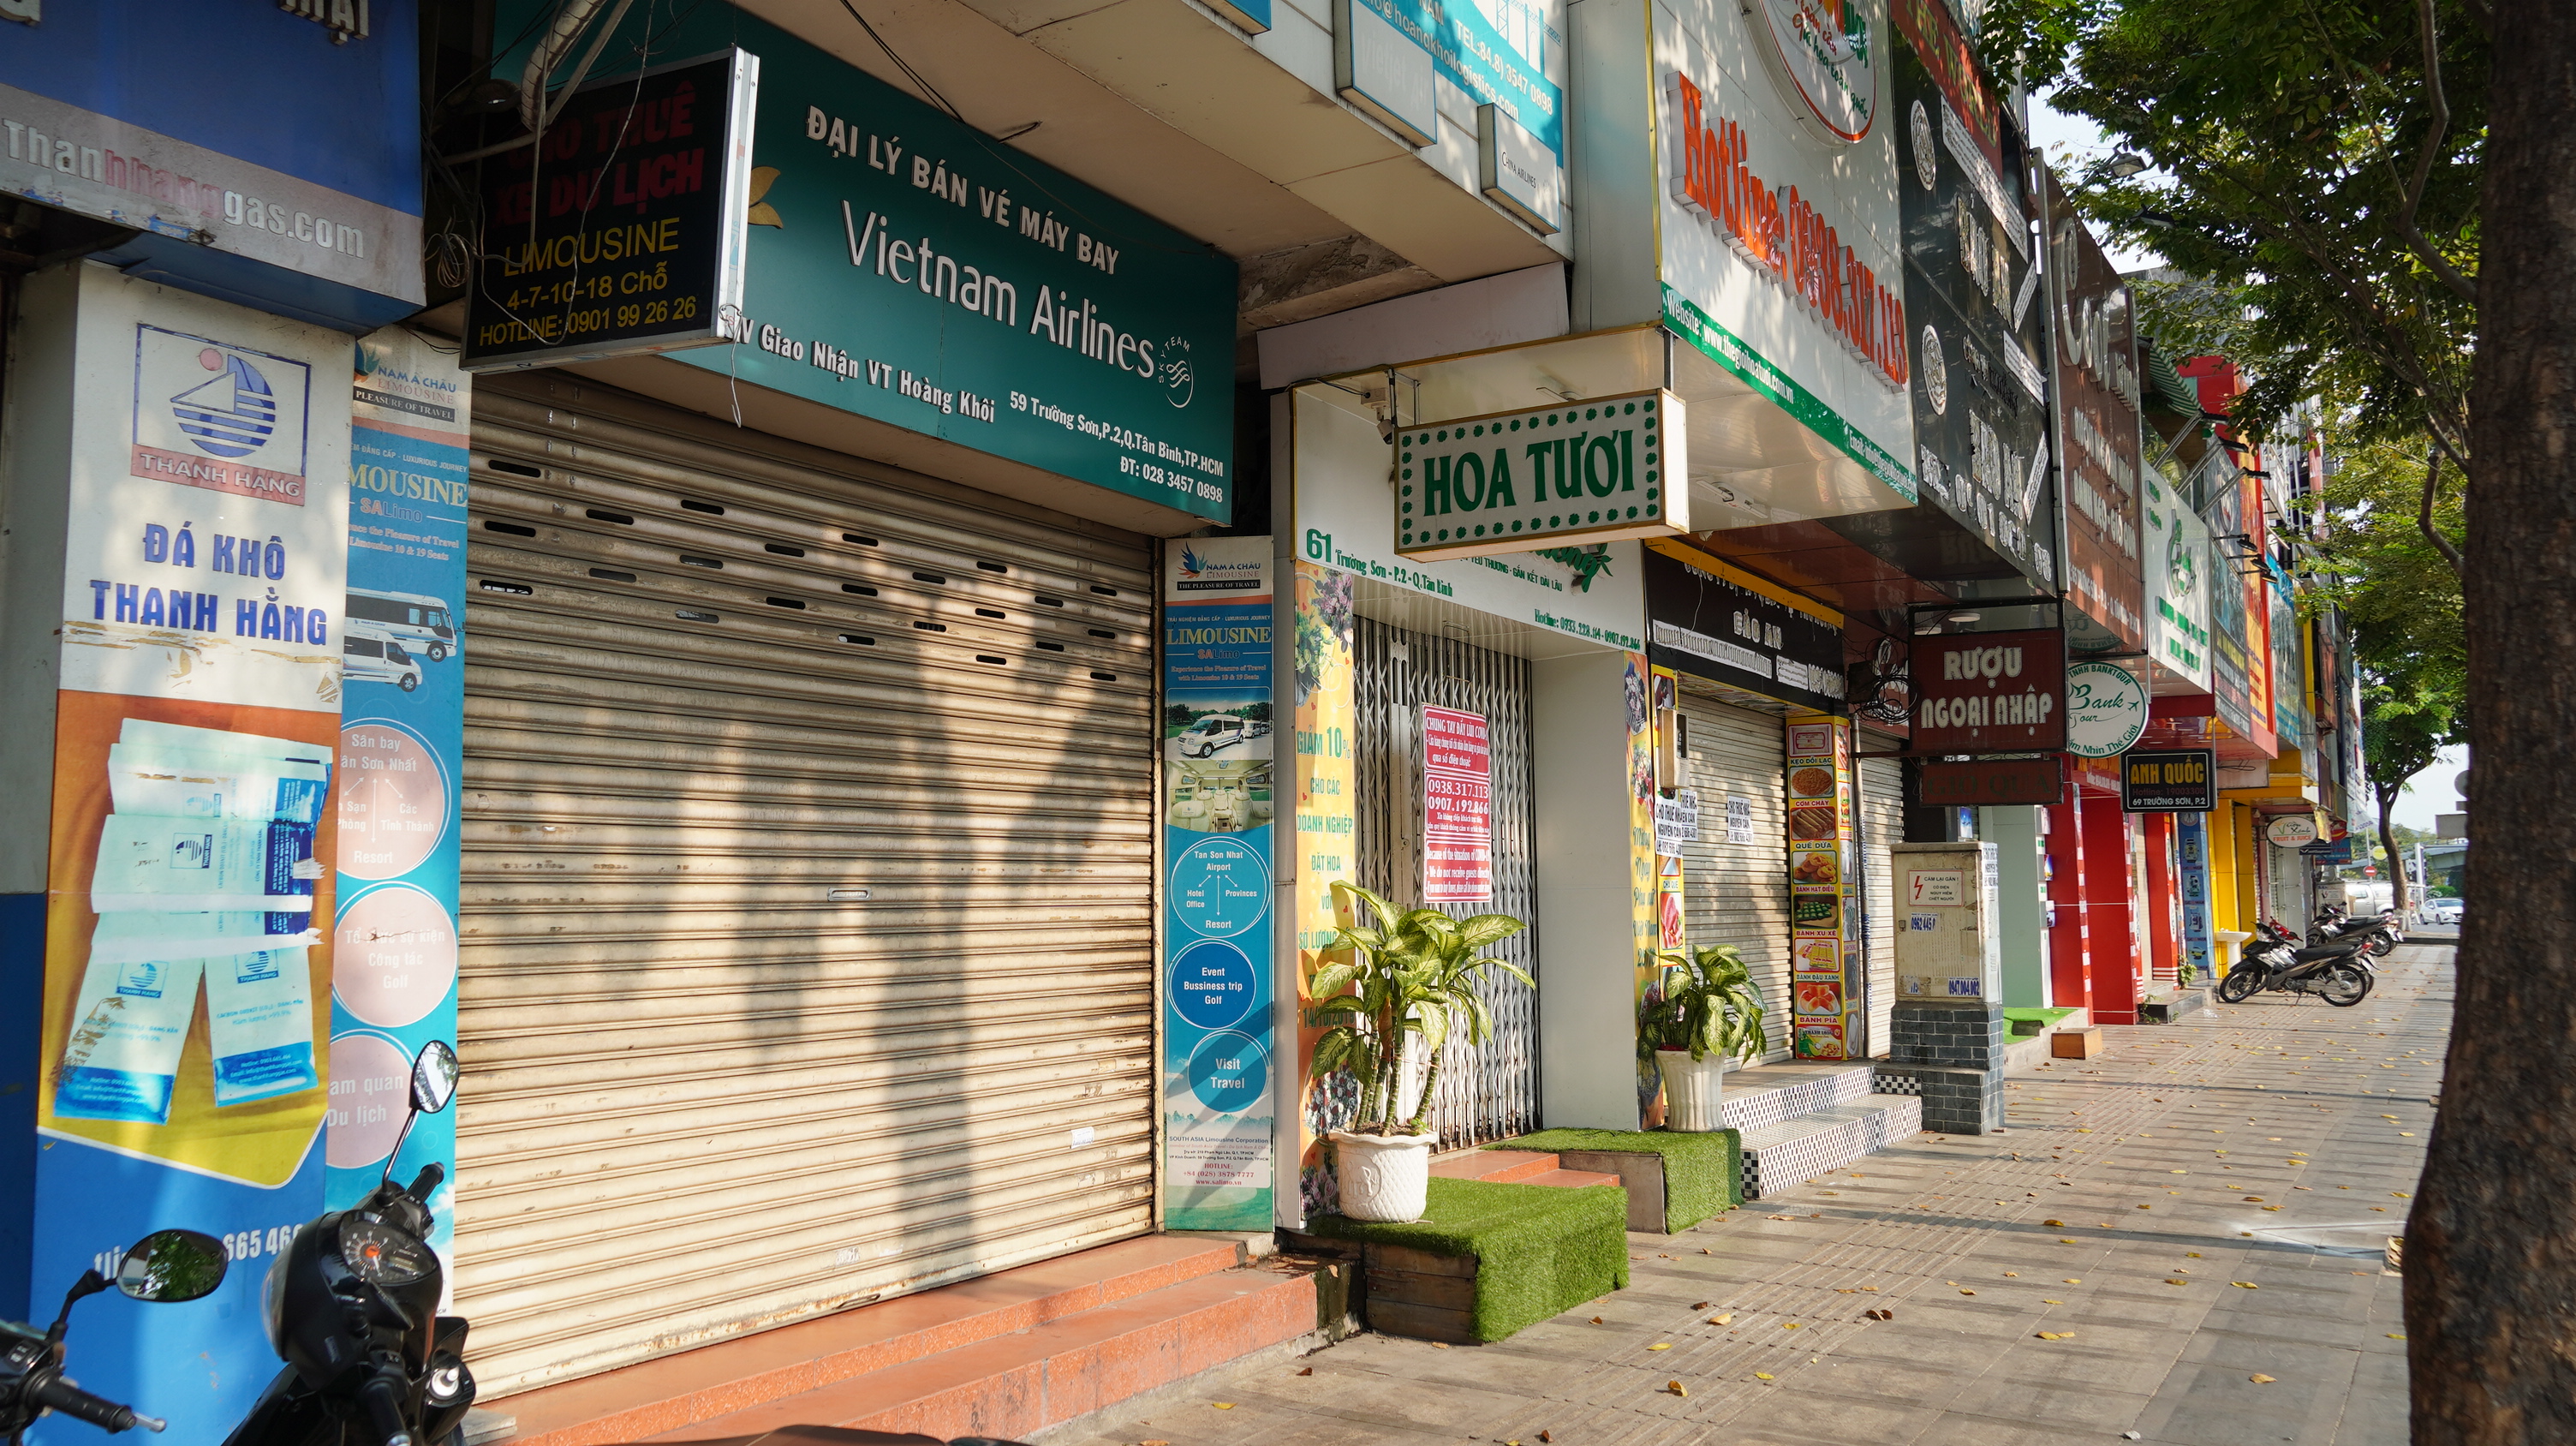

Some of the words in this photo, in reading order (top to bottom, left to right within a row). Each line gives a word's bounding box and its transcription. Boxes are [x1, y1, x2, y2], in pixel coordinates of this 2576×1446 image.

[1506, 64, 1529, 96] 3547
[1530, 83, 1553, 117] 0898
[1501, 152, 1517, 175] CHINA
[1518, 166, 1536, 189] AIRLINES
[1673, 71, 1787, 283] Hotline:
[2, 117, 365, 260] Thanhhanggas.com
[549, 168, 600, 218] DU
[612, 147, 705, 214] LỊCH
[806, 105, 858, 158] ĐẠI
[868, 135, 902, 175] LÝ
[912, 154, 967, 207] BÁN
[978, 185, 1011, 229] VÉ
[1020, 206, 1070, 252] MÁY
[1076, 232, 1119, 274] BAY
[504, 217, 680, 277] LIMOUSINE
[507, 276, 612, 311] 4-7-10-18
[620, 260, 668, 293] Chỗ
[841, 199, 1017, 326] Vietnam
[1029, 284, 1155, 378] Airlines
[480, 318, 562, 346] HOTLINE:
[568, 308, 611, 333] 0901
[617, 303, 641, 328] 99
[646, 298, 668, 323] 26
[672, 295, 696, 320] 26
[1667, 290, 1702, 338] Website:
[1703, 322, 1794, 405] www.thegioihoatuoi.com.vn
[378, 366, 408, 382] NAM
[760, 324, 804, 361] Giao
[811, 340, 858, 382] Nhận
[867, 359, 892, 389] VT
[898, 369, 952, 414] Hoàng
[958, 390, 995, 423] Khôi
[378, 378, 454, 404] LIMOUSINE
[355, 390, 404, 409] PLEASURE
[405, 401, 417, 411] OF
[418, 404, 454, 420] TRAVEL
[1010, 391, 1028, 411] 59
[1031, 397, 1075, 430] Trường
[1158, 440, 1224, 477] Bình,TP.HCM
[140, 453, 228, 485] THANH
[402, 455, 438, 467] LUXURIOUS
[439, 461, 468, 473] JOURNEY
[1423, 447, 1517, 517] HOA
[1525, 429, 1635, 503] TƯƠI
[1120, 456, 1140, 477] ĐT:
[1142, 463, 1164, 484] 028
[1167, 471, 1194, 493] 3457
[1196, 481, 1223, 504] 0898
[361, 497, 422, 523] SALimo
[142, 520, 195, 569] ĐÁ
[212, 535, 286, 581] KHÔ
[1306, 529, 1332, 563] 61
[1335, 549, 1368, 576] Trường
[1370, 559, 1386, 579] Sơn
[1393, 565, 1407, 583] P.2
[1412, 571, 1434, 592] Q.Tân
[1437, 577, 1453, 597] Bình
[90, 580, 218, 632] THANH
[1166, 626, 1271, 645] LIMOUSINE
[1944, 646, 2022, 689] RƯỢU
[2068, 665, 2089, 678] TNHH
[2091, 665, 2132, 685] BANKTOUR
[2069, 682, 2124, 710] Bank
[1921, 696, 1989, 737] NGOẠI
[1995, 684, 2053, 736] NHẬP
[2069, 712, 2098, 729] Tour
[1427, 717, 1446, 732] CHUNG
[1446, 720, 1456, 734] TAY
[352, 732, 377, 749] Sân
[380, 736, 401, 752] bay
[1297, 726, 1323, 757] GIẢM
[2083, 744, 2104, 755] Nhìn
[2106, 736, 2123, 752] Thế
[2122, 724, 2138, 743] Giới
[361, 755, 385, 771] Sơn
[389, 756, 417, 774] Nhất
[2131, 763, 2159, 785] ANH
[2164, 755, 2204, 786] QUỐC
[1309, 778, 1325, 795] CHO
[1327, 775, 1340, 796] CÁC
[1428, 779, 1488, 798] 0938.317.113
[2132, 787, 2163, 797] Hotline:
[2166, 786, 2204, 797] 19003300
[348, 801, 367, 815] Sạn
[400, 801, 418, 815] Các
[1428, 796, 1488, 815] 0907.192.866
[2144, 796, 2174, 806] TRƯỜNG
[2175, 796, 2194, 807] SƠN,
[2195, 797, 2206, 805] P.2
[1297, 815, 1323, 834] DOANH
[1326, 814, 1353, 838] NGHIỆP
[354, 850, 393, 864] Resort
[1194, 851, 1208, 859] Tan
[1210, 851, 1224, 859] Son
[1226, 851, 1243, 859] Nhat
[1327, 854, 1341, 872] HOA
[1206, 863, 1231, 872] Airport
[1187, 889, 1204, 898] Hotel
[1225, 889, 1257, 898] Provinces
[1205, 919, 1231, 929] Resort
[1298, 925, 1309, 950] SỐ
[368, 953, 400, 969] Công
[1202, 967, 1225, 977] Event
[383, 974, 408, 989] Golf
[1184, 981, 1225, 991] Bussiness
[1228, 980, 1243, 993] trip
[1204, 995, 1222, 1005] Golf
[1799, 1015, 1822, 1024] BÁNH
[1215, 1058, 1241, 1071] Visit
[364, 1076, 403, 1097] quan
[1210, 1076, 1245, 1089] Travel
[326, 1108, 352, 1127] Du
[356, 1106, 387, 1126] lịch
